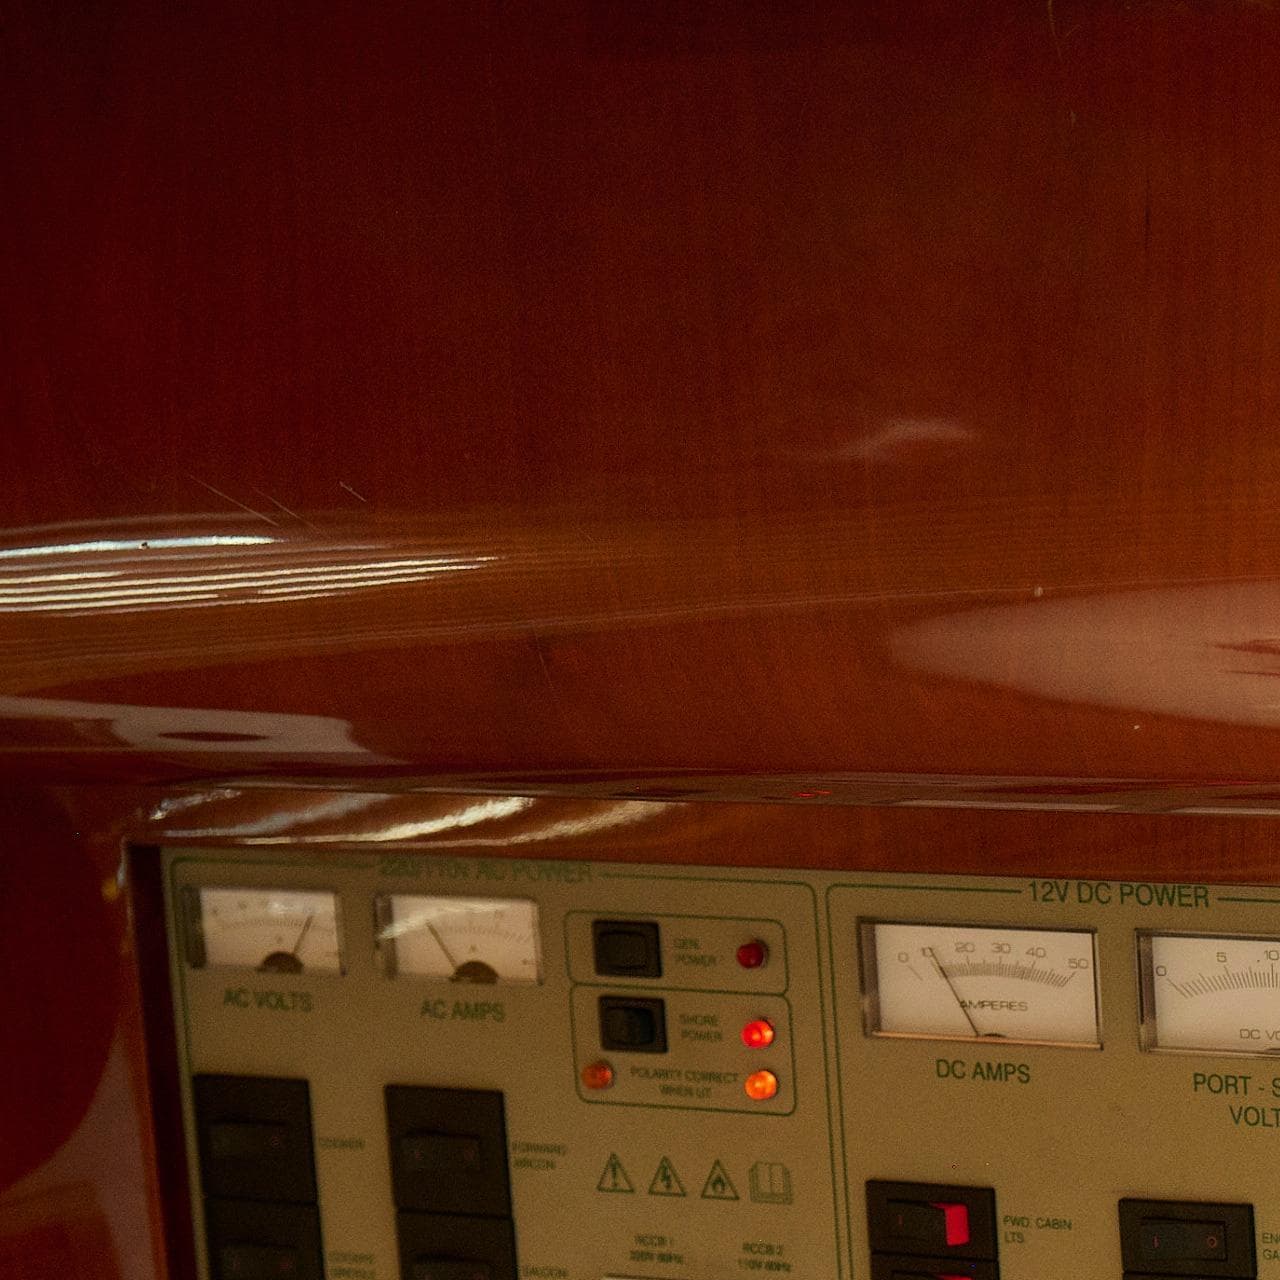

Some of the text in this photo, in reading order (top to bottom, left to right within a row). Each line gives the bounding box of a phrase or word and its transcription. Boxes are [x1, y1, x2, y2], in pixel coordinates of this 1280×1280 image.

[1028, 880, 1210, 908] 12V DC POWER
[954, 942, 975, 955] 20
[990, 943, 1012, 955] 30
[1025, 946, 1046, 959] 40
[1068, 957, 1090, 970] 50
[1216, 951, 1227, 964] 5
[223, 986, 313, 1014] AC VOLTS
[419, 997, 507, 1023] AC AMPS
[935, 1058, 1031, 1084] DC AMPS
[1192, 1072, 1251, 1096] PORT
[1036, 1217, 1072, 1232] CABIN
